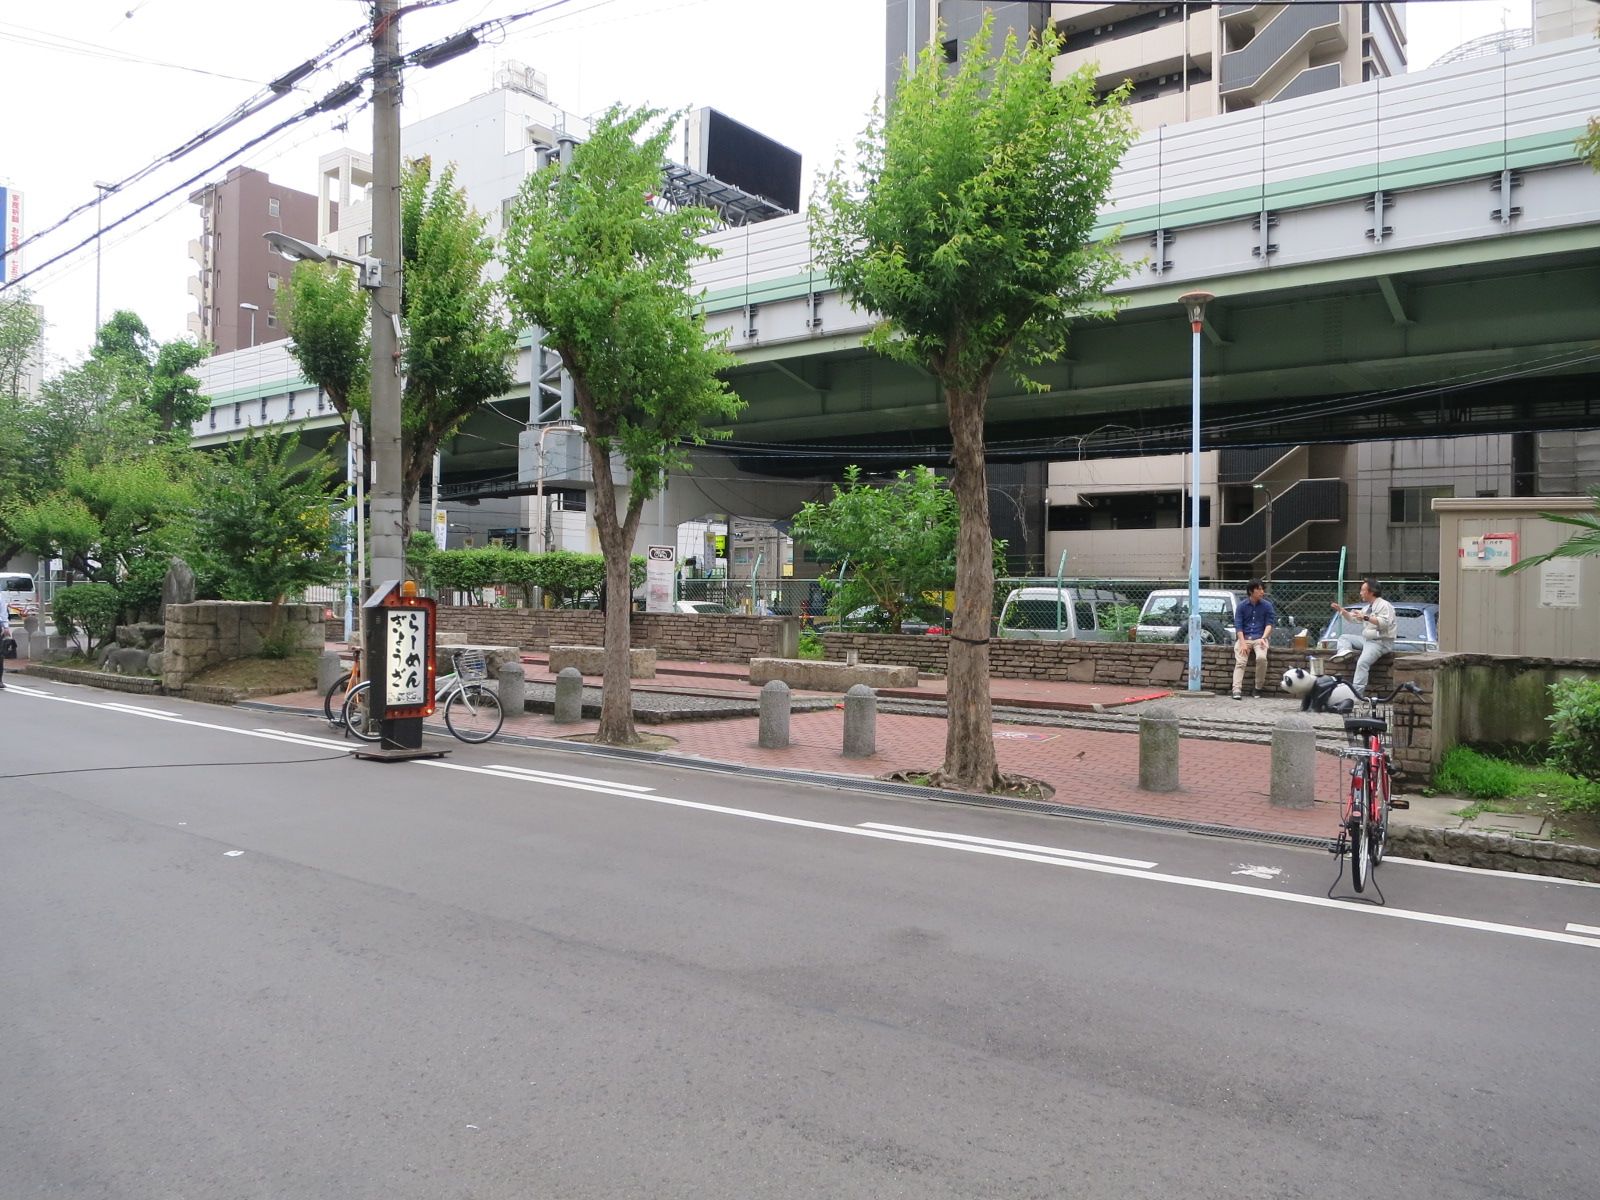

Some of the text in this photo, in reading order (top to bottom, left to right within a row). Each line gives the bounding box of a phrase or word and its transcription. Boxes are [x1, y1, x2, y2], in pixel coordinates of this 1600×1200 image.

[390, 613, 407, 688] ぎょうざ
[405, 613, 421, 689] らーめん
